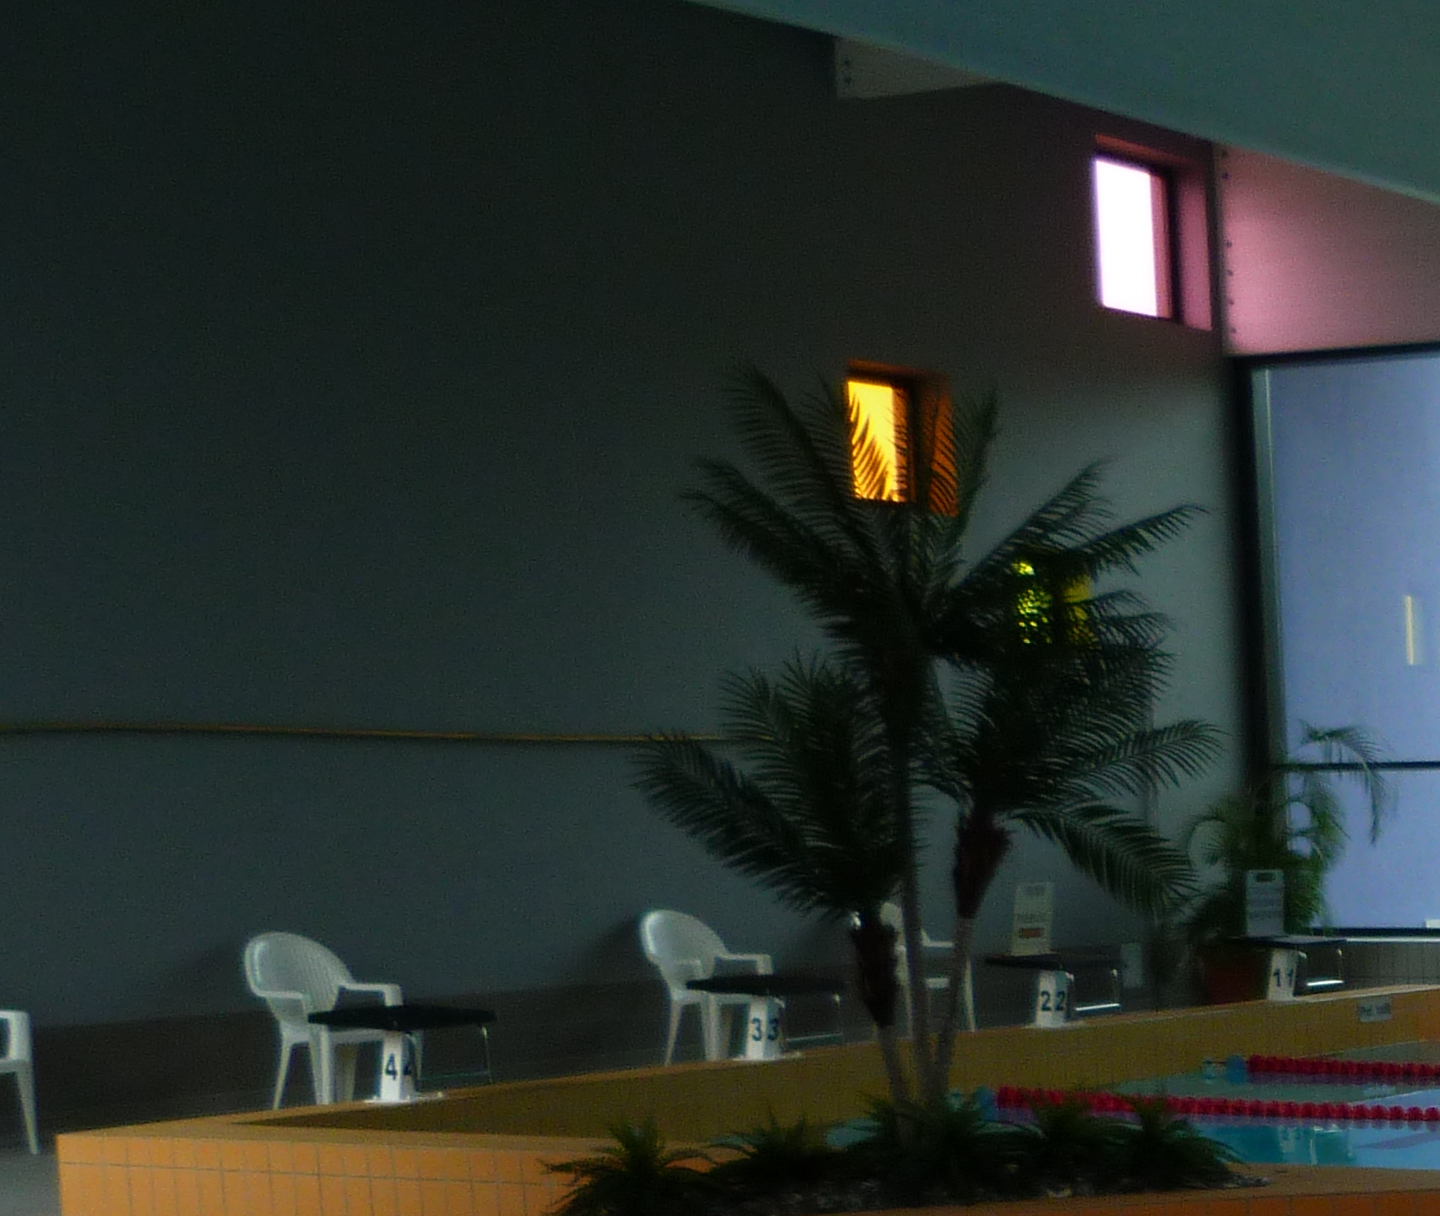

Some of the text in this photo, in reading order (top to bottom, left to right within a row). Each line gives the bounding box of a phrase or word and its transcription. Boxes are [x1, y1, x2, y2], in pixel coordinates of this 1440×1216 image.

[1273, 968, 1281, 988] 1
[1041, 990, 1051, 1011] 2
[1055, 990, 1066, 1011] 2
[752, 1018, 763, 1042] 3
[767, 1018, 779, 1042] 3
[385, 1053, 398, 1082] 4
